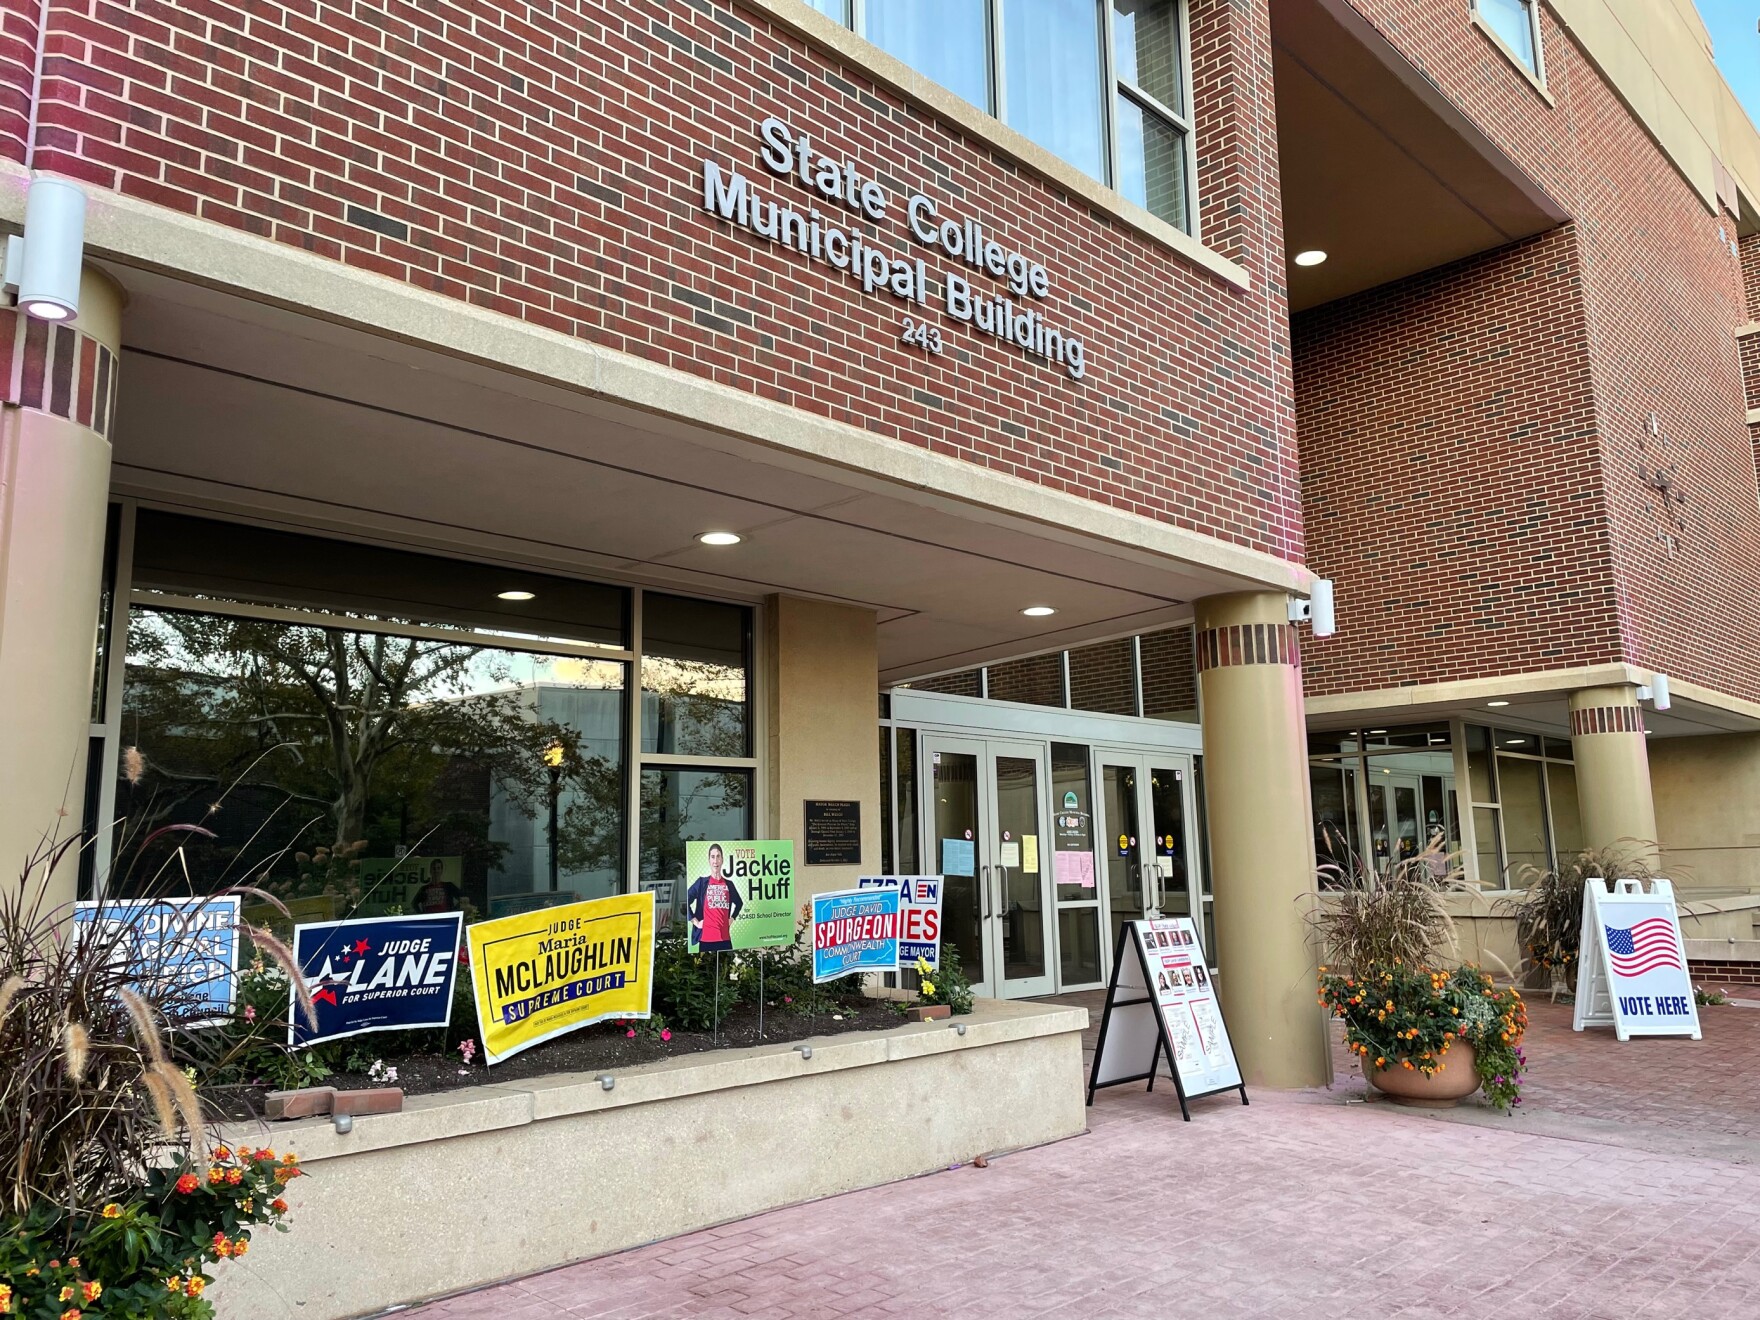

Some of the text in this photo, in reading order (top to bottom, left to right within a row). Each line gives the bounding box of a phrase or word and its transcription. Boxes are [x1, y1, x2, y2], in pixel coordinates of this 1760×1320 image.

[760, 117, 1049, 297] State College
[703, 158, 1085, 379] Municipal Building
[901, 317, 943, 354] 243
[735, 849, 755, 859] VOTE
[722, 854, 791, 878] Jackie
[749, 877, 790, 900] Huff
[757, 911, 772, 919] School
[831, 903, 883, 919] JUDGE DAVID
[547, 918, 582, 936] JUDGE
[818, 914, 893, 948] SPURGEON
[378, 938, 432, 956] JUDGE
[538, 933, 588, 956] Maria
[910, 946, 935, 958] MAYOR
[495, 937, 632, 999] MCLAUGHLIN
[842, 951, 863, 964] COURT
[346, 951, 453, 993] LANE
[342, 986, 440, 1005] FOR SUPERIOR COURT
[508, 986, 569, 1021] SUPREME
[576, 973, 622, 996] COURT
[1619, 996, 1689, 1016] VOTE HERE
